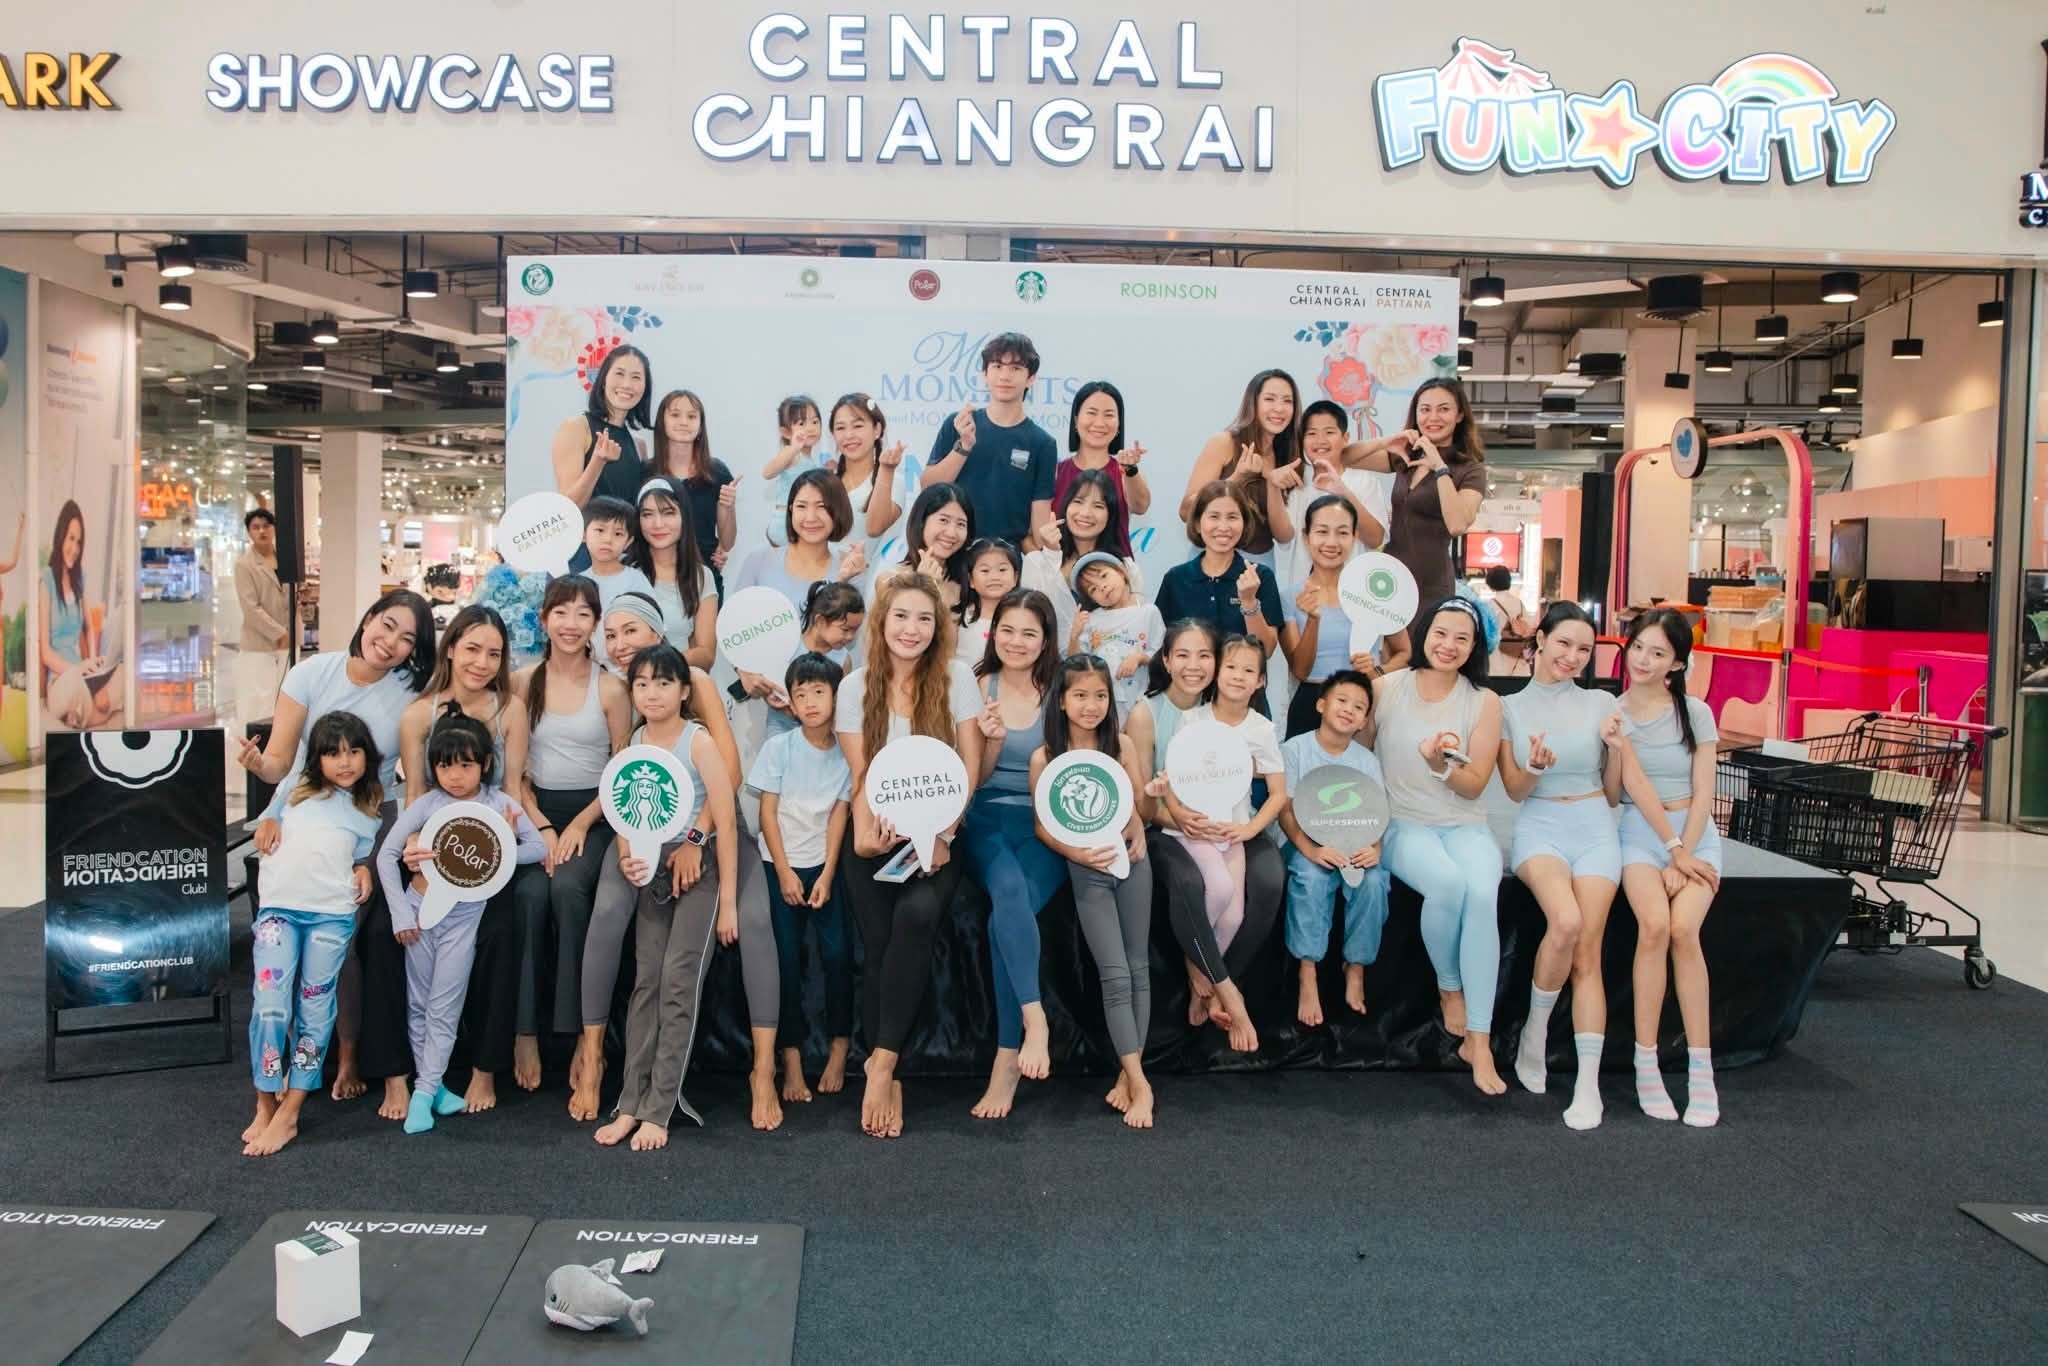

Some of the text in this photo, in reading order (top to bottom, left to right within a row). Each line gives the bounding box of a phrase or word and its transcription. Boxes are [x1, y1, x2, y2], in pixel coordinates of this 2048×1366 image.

[749, 12, 1223, 89] CENTRAL
[206, 53, 614, 113] SHOWCASE
[692, 93, 1273, 171] CHIANGRAI
[1378, 69, 1896, 183] FUN CITY
[1120, 283, 1217, 299] ROBINSON
[1296, 284, 1359, 296] CENTRAL
[1376, 287, 1432, 299] CENTRAL
[1289, 295, 1366, 307] CHIANGRAI
[1376, 299, 1432, 310] PATTANA
[512, 513, 565, 544] CENTRAL
[1342, 590, 1408, 625] FRIENDCATION
[722, 609, 794, 650] ROBINSON
[881, 773, 952, 791] CENTRAL
[875, 784, 962, 804] CHIANGRAI
[63, 848, 208, 870] FRIENDCATION
[444, 834, 489, 869] Polar
[88, 956, 194, 973] #FRIENDCATIONCLUB
[305, 1221, 488, 1236] FRIENDCATION
[576, 1230, 758, 1245] FRIENDCATION
